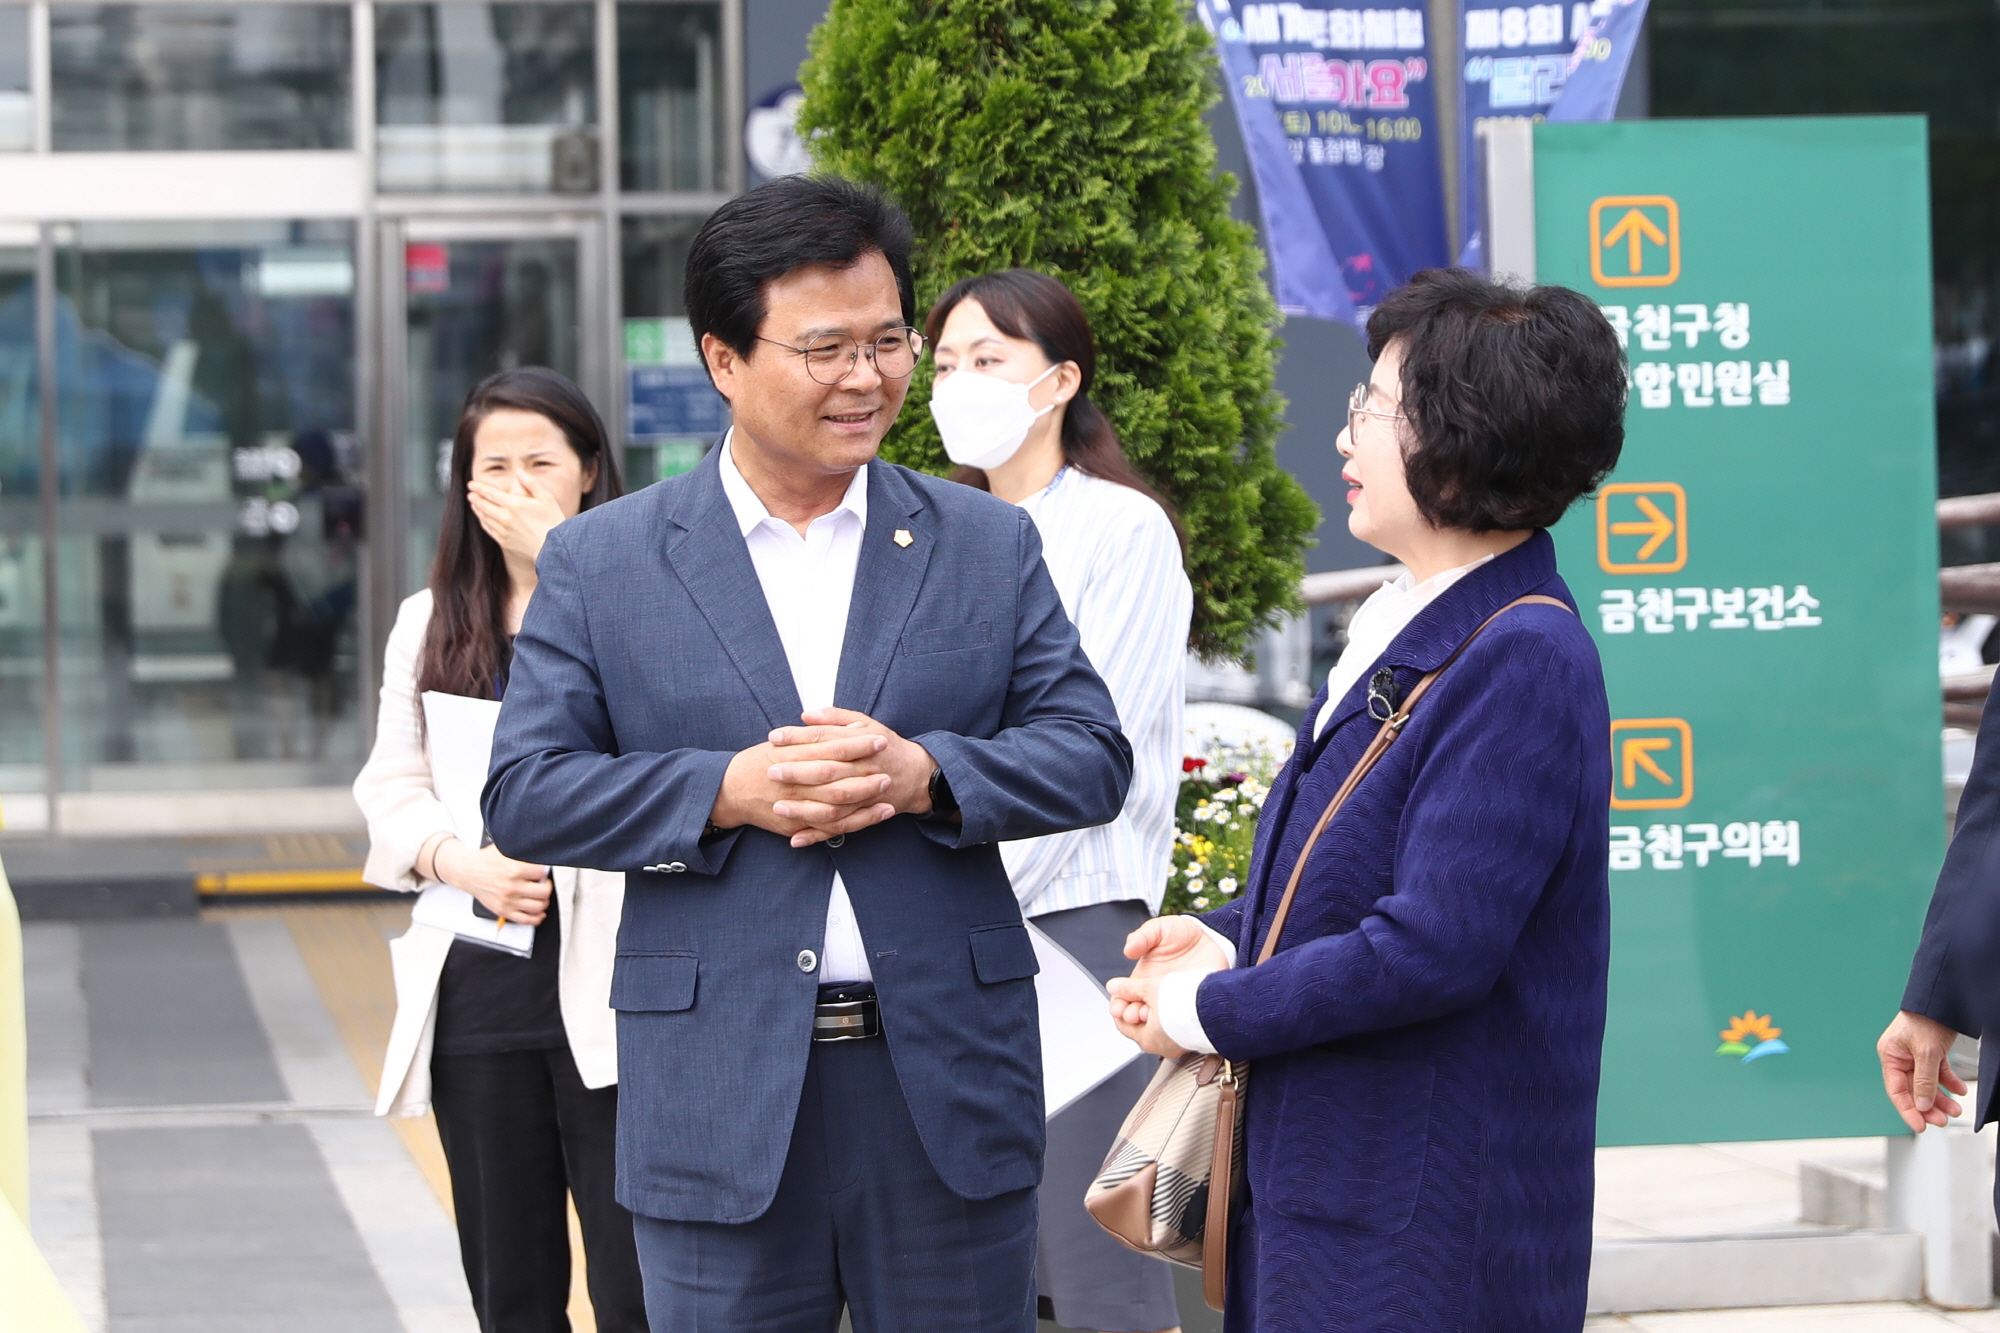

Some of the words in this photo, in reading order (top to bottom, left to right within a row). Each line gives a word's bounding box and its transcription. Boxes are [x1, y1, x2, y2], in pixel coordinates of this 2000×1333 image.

[1602, 303, 1750, 351] 금천구청
[1628, 359, 1790, 409] 합민원실
[1598, 585, 1822, 634] 금천구보건소
[1609, 820, 1800, 870] 금천구의회
